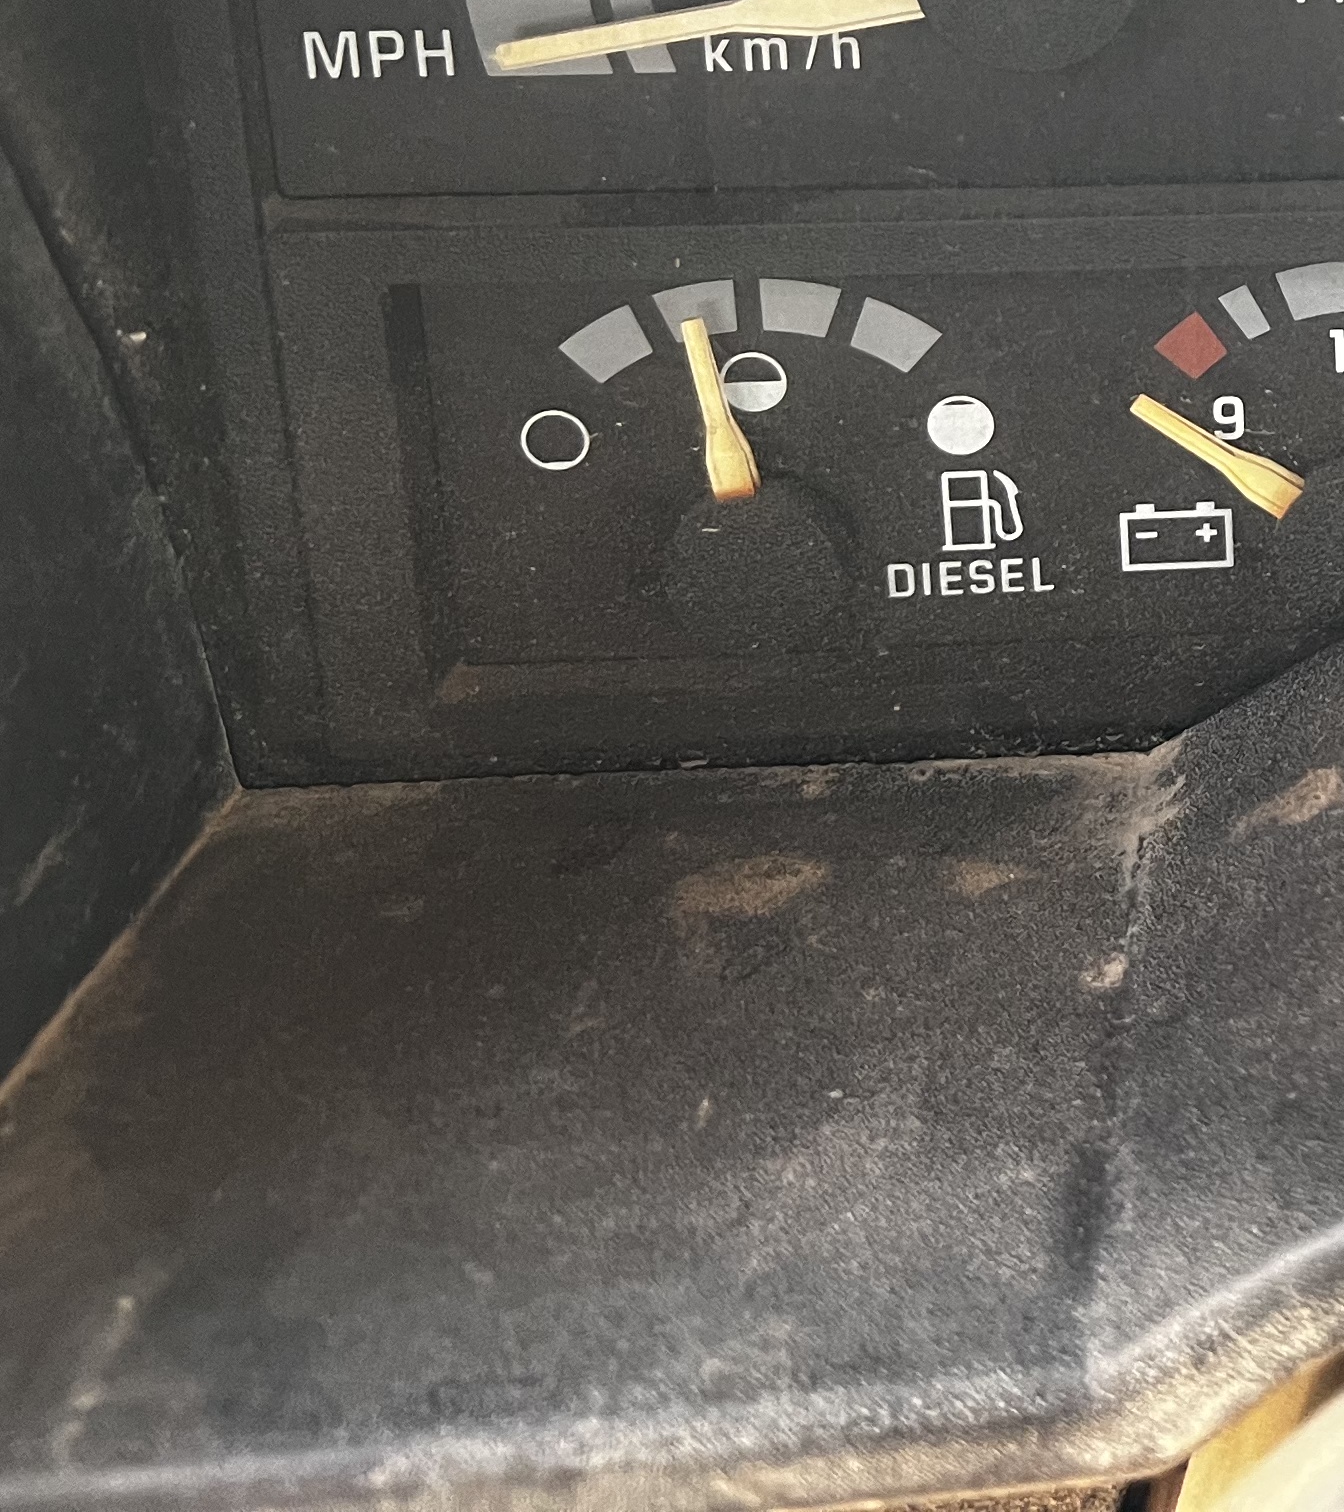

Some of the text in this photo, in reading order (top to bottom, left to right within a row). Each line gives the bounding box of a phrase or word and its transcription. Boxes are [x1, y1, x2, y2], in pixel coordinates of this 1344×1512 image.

[303, 29, 456, 79] MPH
[704, 28, 861, 73] km/h
[1211, 395, 1246, 441] 9
[887, 557, 1056, 600] DIESEL
